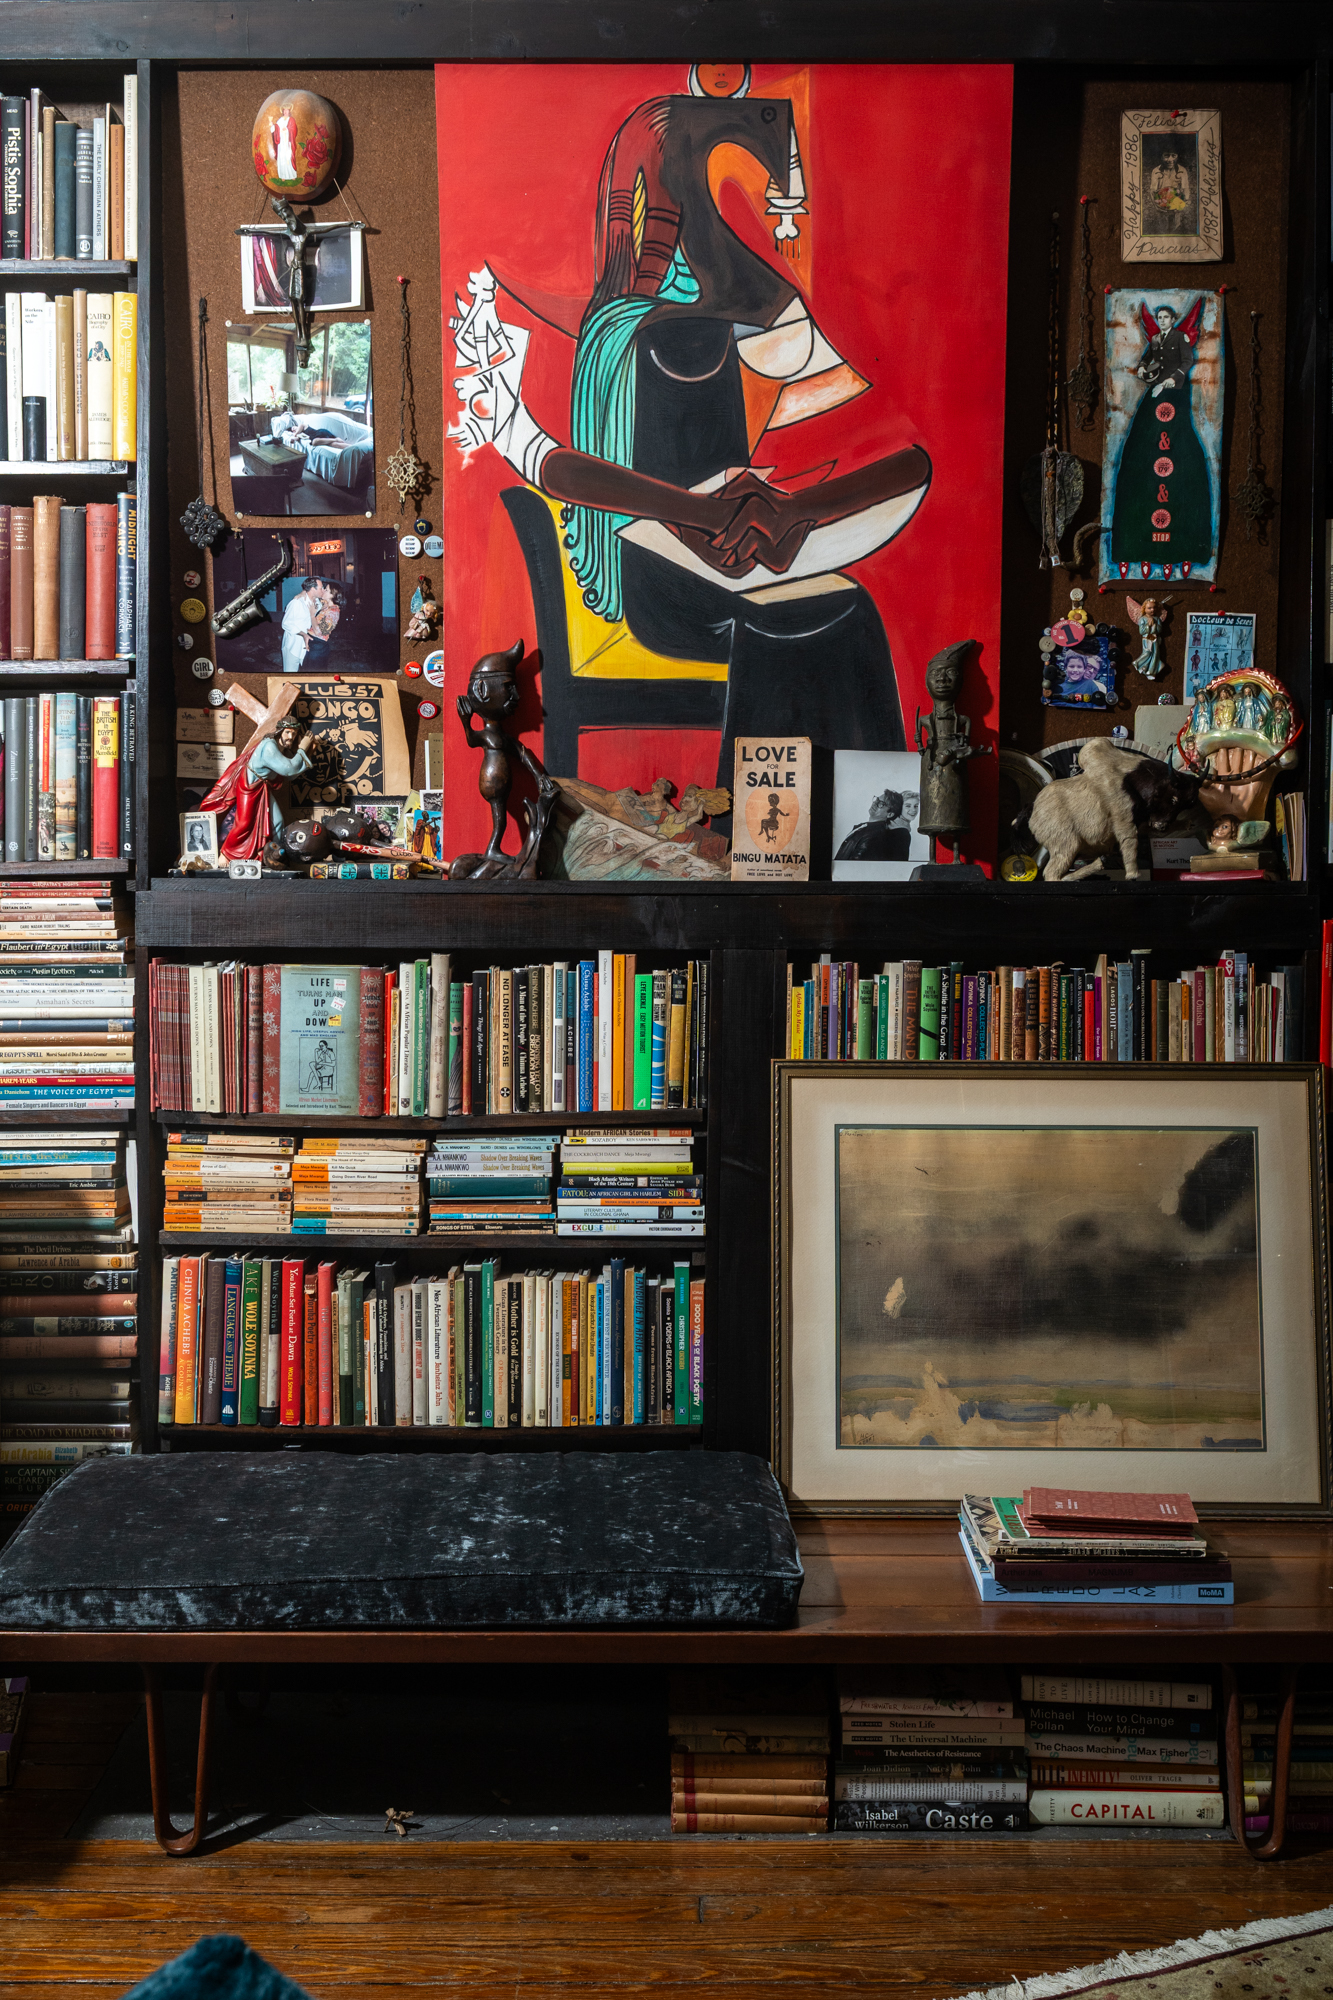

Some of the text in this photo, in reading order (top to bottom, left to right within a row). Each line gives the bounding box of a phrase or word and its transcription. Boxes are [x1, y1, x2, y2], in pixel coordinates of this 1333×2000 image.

[1132, 113, 1195, 128] Felices
[1124, 132, 1138, 168] 1986
[5, 127, 21, 215] Pistis Sophia
[1200, 126, 1218, 207] Holidays
[1124, 170, 1140, 239] Happy
[1202, 210, 1218, 242] 1987
[1135, 241, 1207, 256] Pascuas
[120, 299, 133, 339] CAIRO
[1158, 432, 1170, 450] &
[1157, 484, 1168, 502] &
[118, 521, 126, 556] CAIRO
[128, 509, 136, 560] MIDNIGHT
[194, 663, 212, 672] GIRL
[300, 701, 375, 719] BONGO
[742, 746, 797, 762] LOVE
[10, 750, 18, 782] Zamalek
[746, 771, 796, 787] SALE
[733, 853, 806, 864] BINGU MATATA
[0, 943, 33, 951] Flaubert
[45, 943, 69, 952] Egypt
[310, 978, 330, 987] LIFE
[503, 978, 510, 991] NO
[940, 981, 948, 1004] Shuttle
[906, 987, 918, 1045] THE MAN
[940, 1014, 948, 1025] the
[1195, 1000, 1204, 1026] Onitsha
[305, 1018, 333, 1027] DOW
[503, 1031, 510, 1042] AT
[939, 1027, 948, 1046] Crypt
[18, 1257, 80, 1267] Lawrence of Arabia
[289, 1268, 298, 1281] You
[270, 1270, 279, 1328] Wole Soyinka
[227, 1291, 236, 1338] LANGUAGE
[244, 1301, 258, 1332] WOLE
[182, 1314, 191, 1355] ACHEBE
[244, 1333, 258, 1379] SOYINKA
[288, 1335, 297, 1361] Dawn
[225, 1354, 234, 1386] THEME
[65, 1428, 116, 1437] KHARTOUM
[1030, 1708, 1075, 1720] Michael
[1087, 1711, 1174, 1727] How to Change
[890, 1720, 935, 1728] Stolen Life
[1030, 1720, 1064, 1731] Pollan
[1087, 1723, 1145, 1735] Your Mind
[890, 1735, 988, 1743] The Universal Machine
[1034, 1742, 1126, 1754] The Chaos Machine
[863, 1765, 881, 1773] Joan
[865, 1810, 898, 1820] Isabel
[925, 1809, 994, 1829] Caste
[1071, 1803, 1155, 1820] CAPITAL
[855, 1821, 909, 1830] Wilkerson
